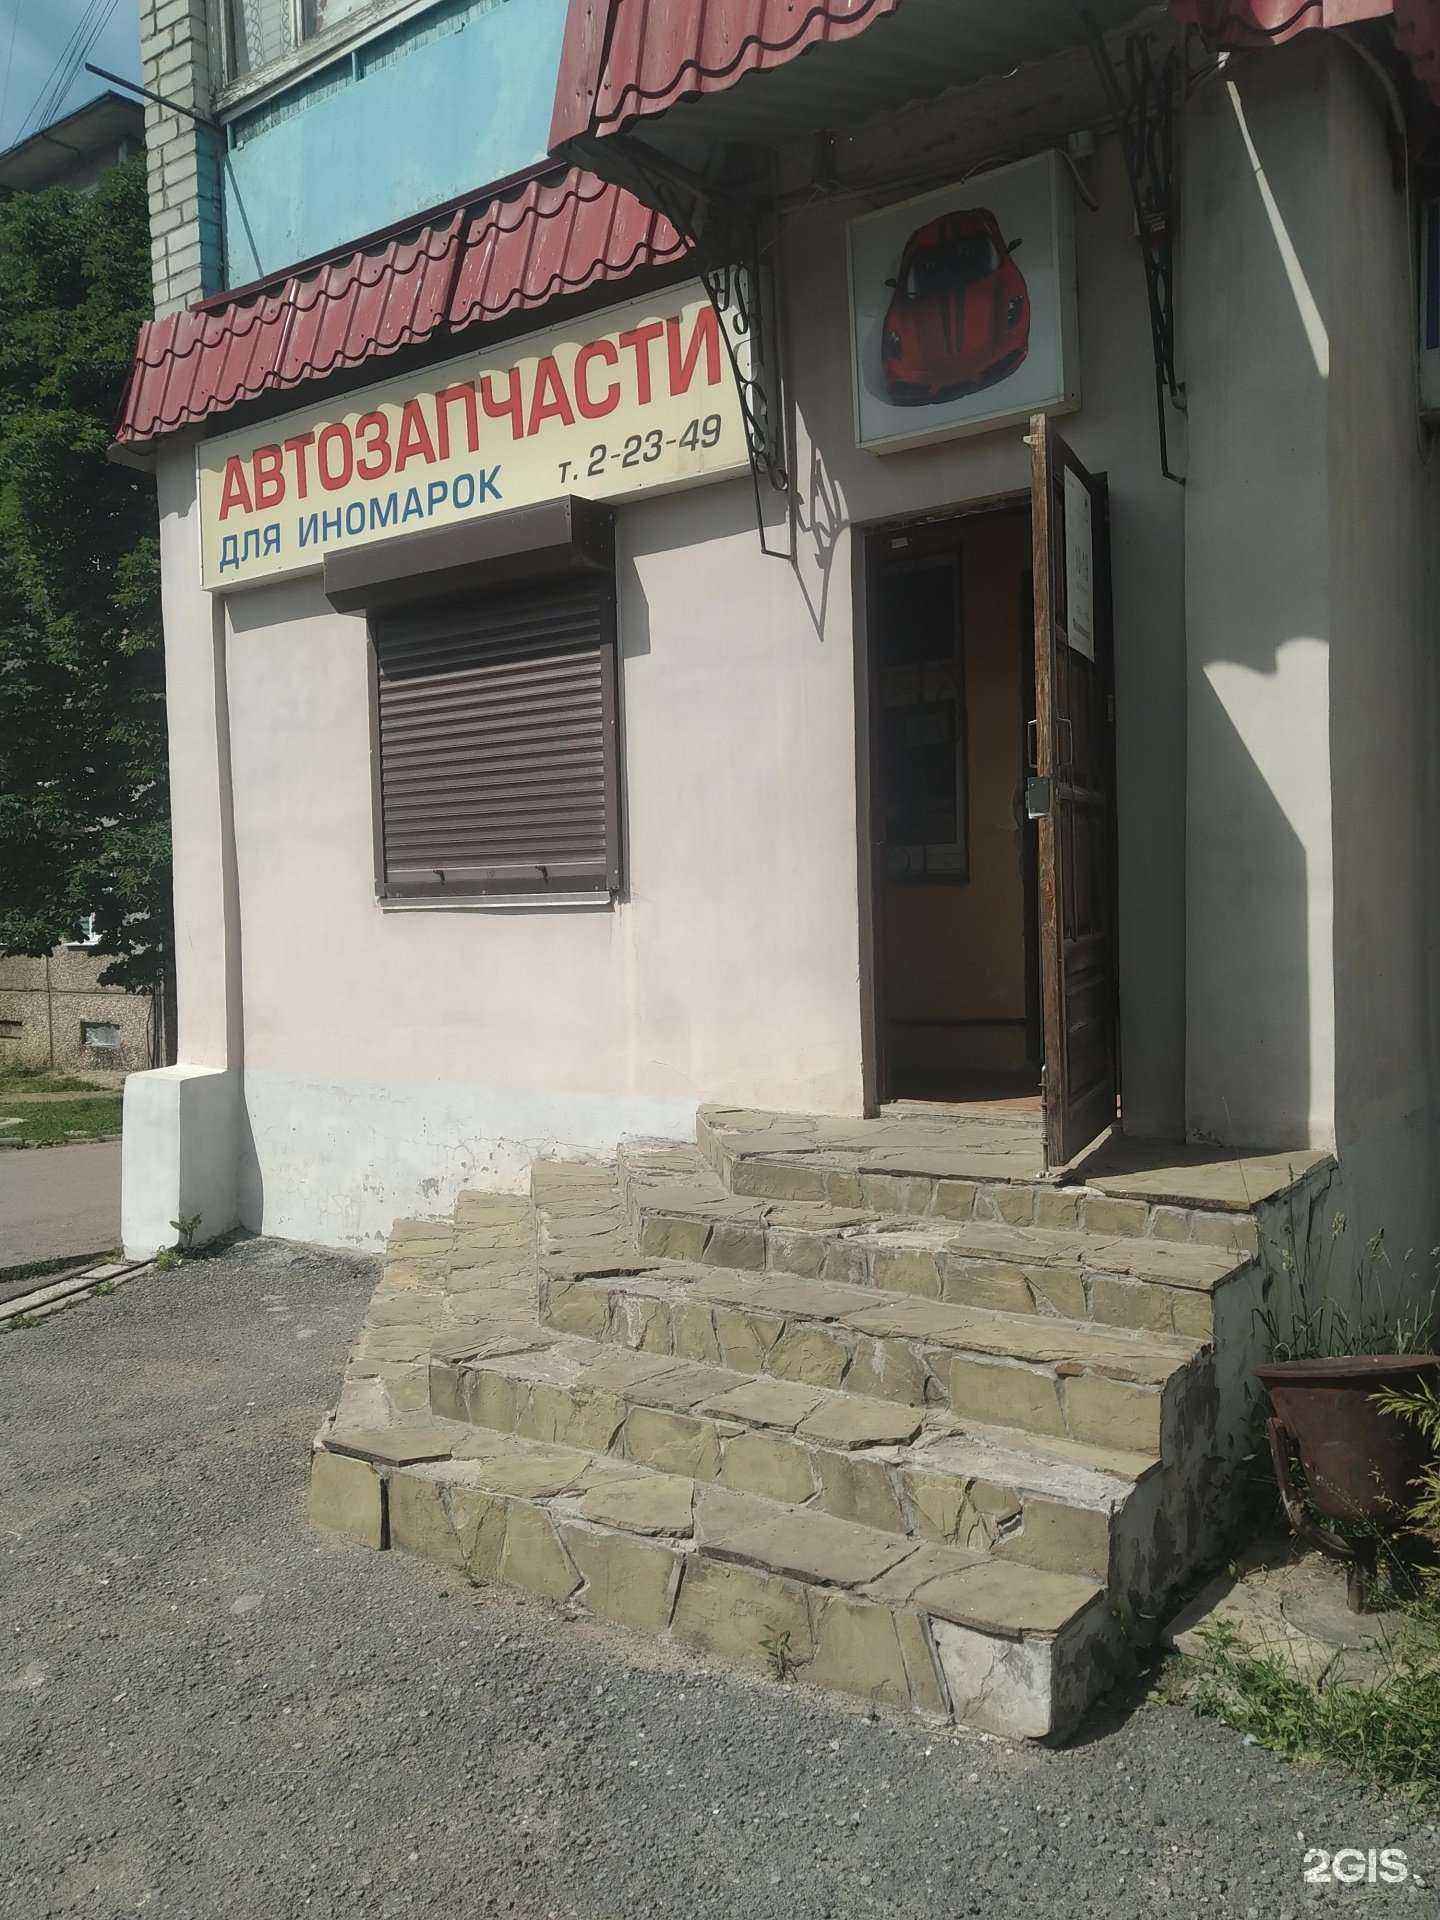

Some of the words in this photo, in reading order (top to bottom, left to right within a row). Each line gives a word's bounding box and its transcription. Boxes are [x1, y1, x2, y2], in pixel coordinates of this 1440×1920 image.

[218, 305, 722, 520] АВТОЗАПЧАСТИ
[587, 414, 722, 477] 2-23-49
[219, 523, 281, 573] ДЛЯ
[299, 465, 503, 547] ИНОМАРОК
